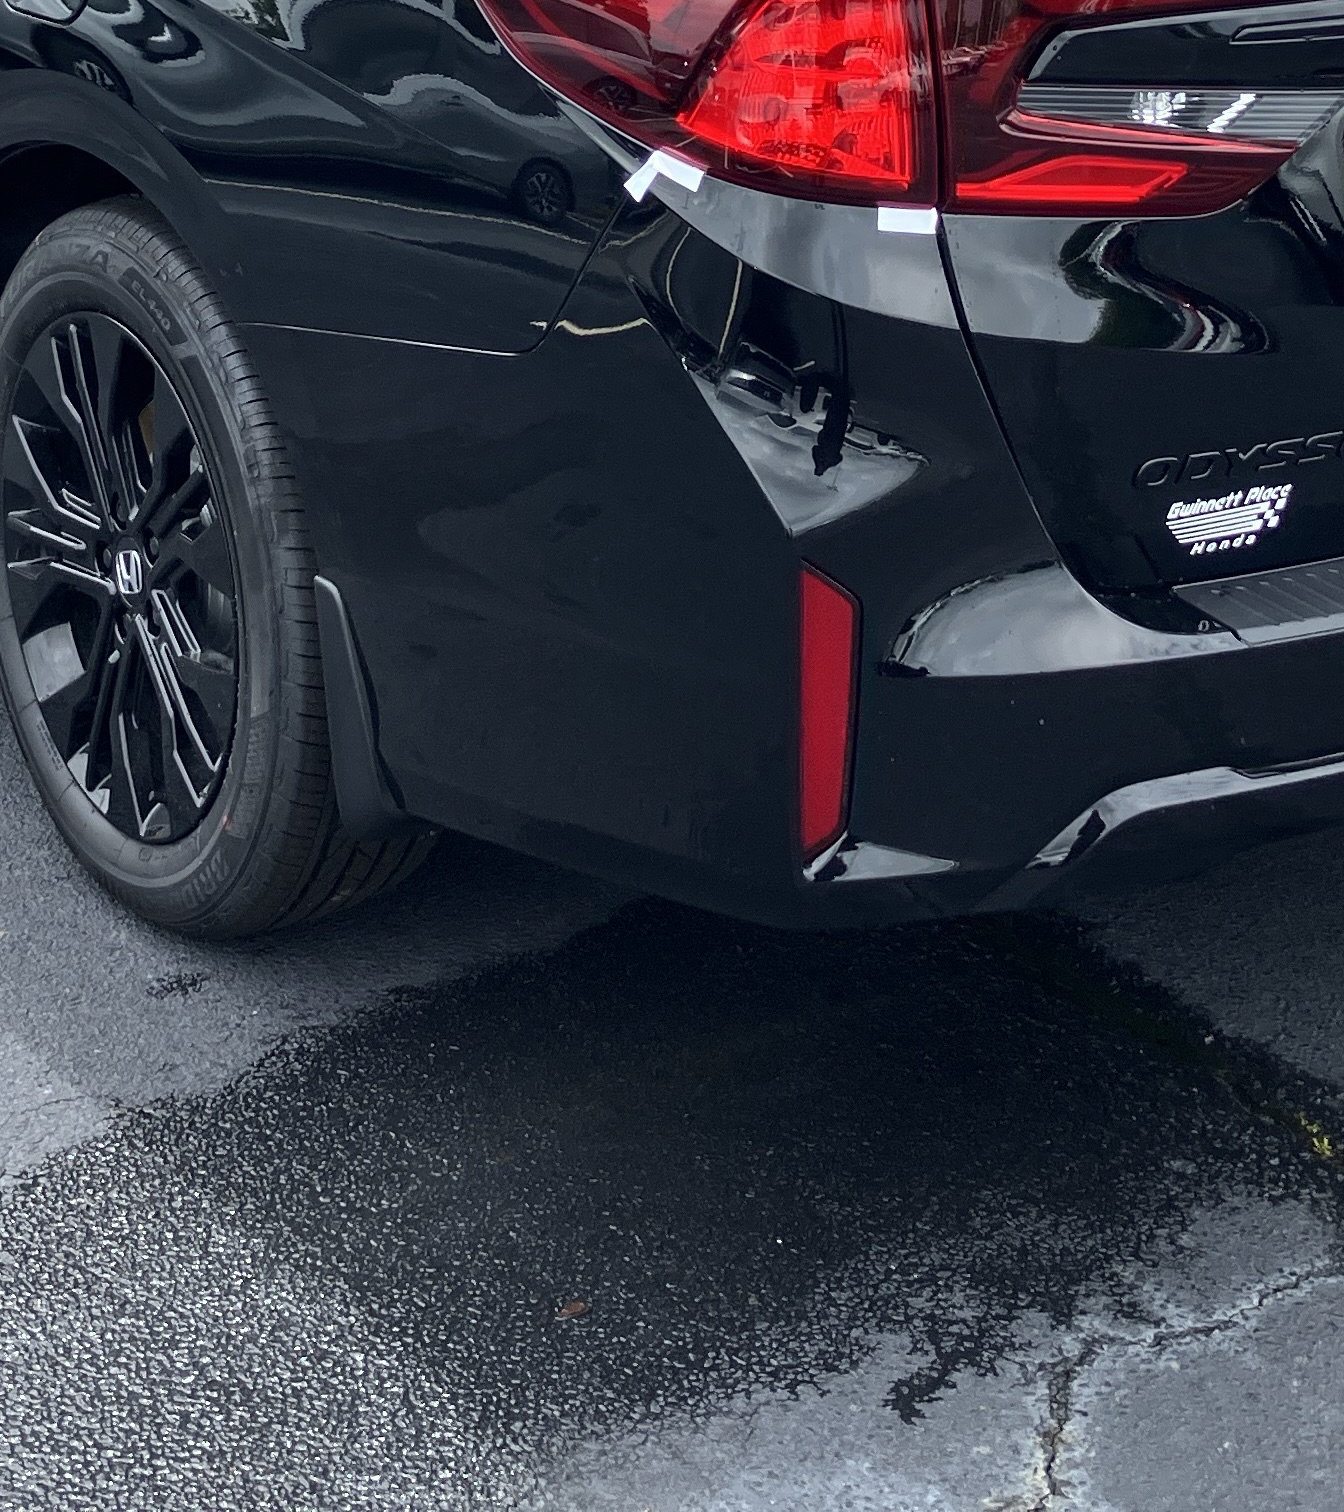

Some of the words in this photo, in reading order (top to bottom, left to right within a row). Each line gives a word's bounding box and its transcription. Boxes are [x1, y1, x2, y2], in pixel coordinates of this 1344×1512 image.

[1167, 490, 1244, 519] Gwinnett
[1244, 483, 1294, 505] Place
[1190, 533, 1257, 556] Honda
